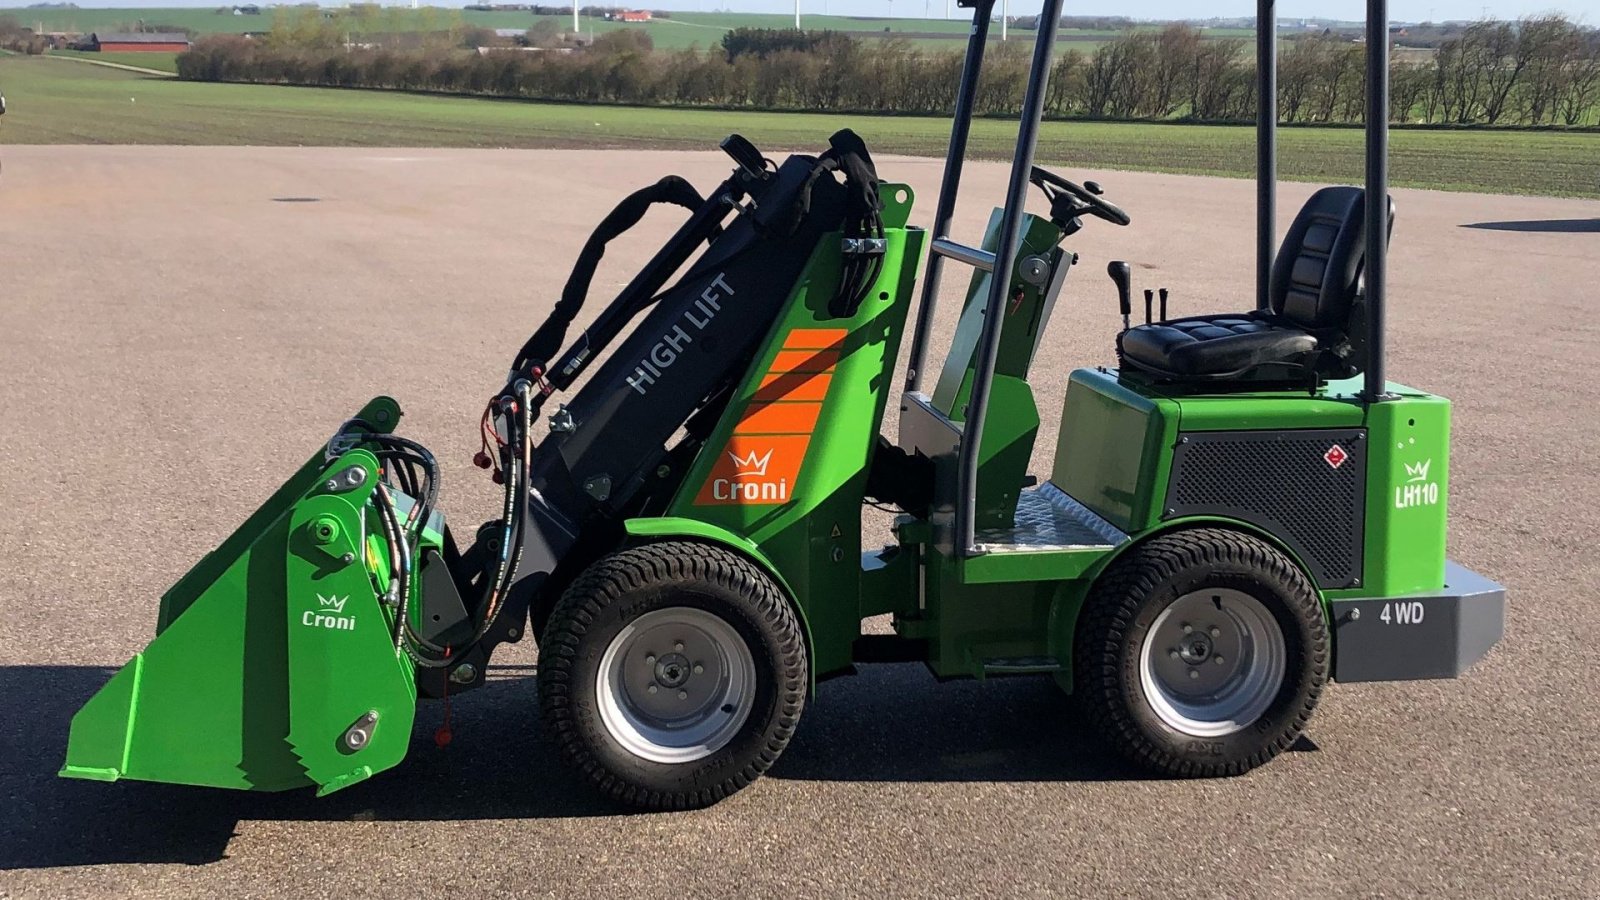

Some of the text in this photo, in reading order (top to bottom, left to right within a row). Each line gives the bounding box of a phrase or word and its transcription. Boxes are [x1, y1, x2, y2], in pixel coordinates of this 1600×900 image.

[626, 272, 736, 395] HIGH LIFT
[713, 478, 786, 500] Croni
[1395, 482, 1438, 508] LH110
[302, 611, 356, 630] Croni
